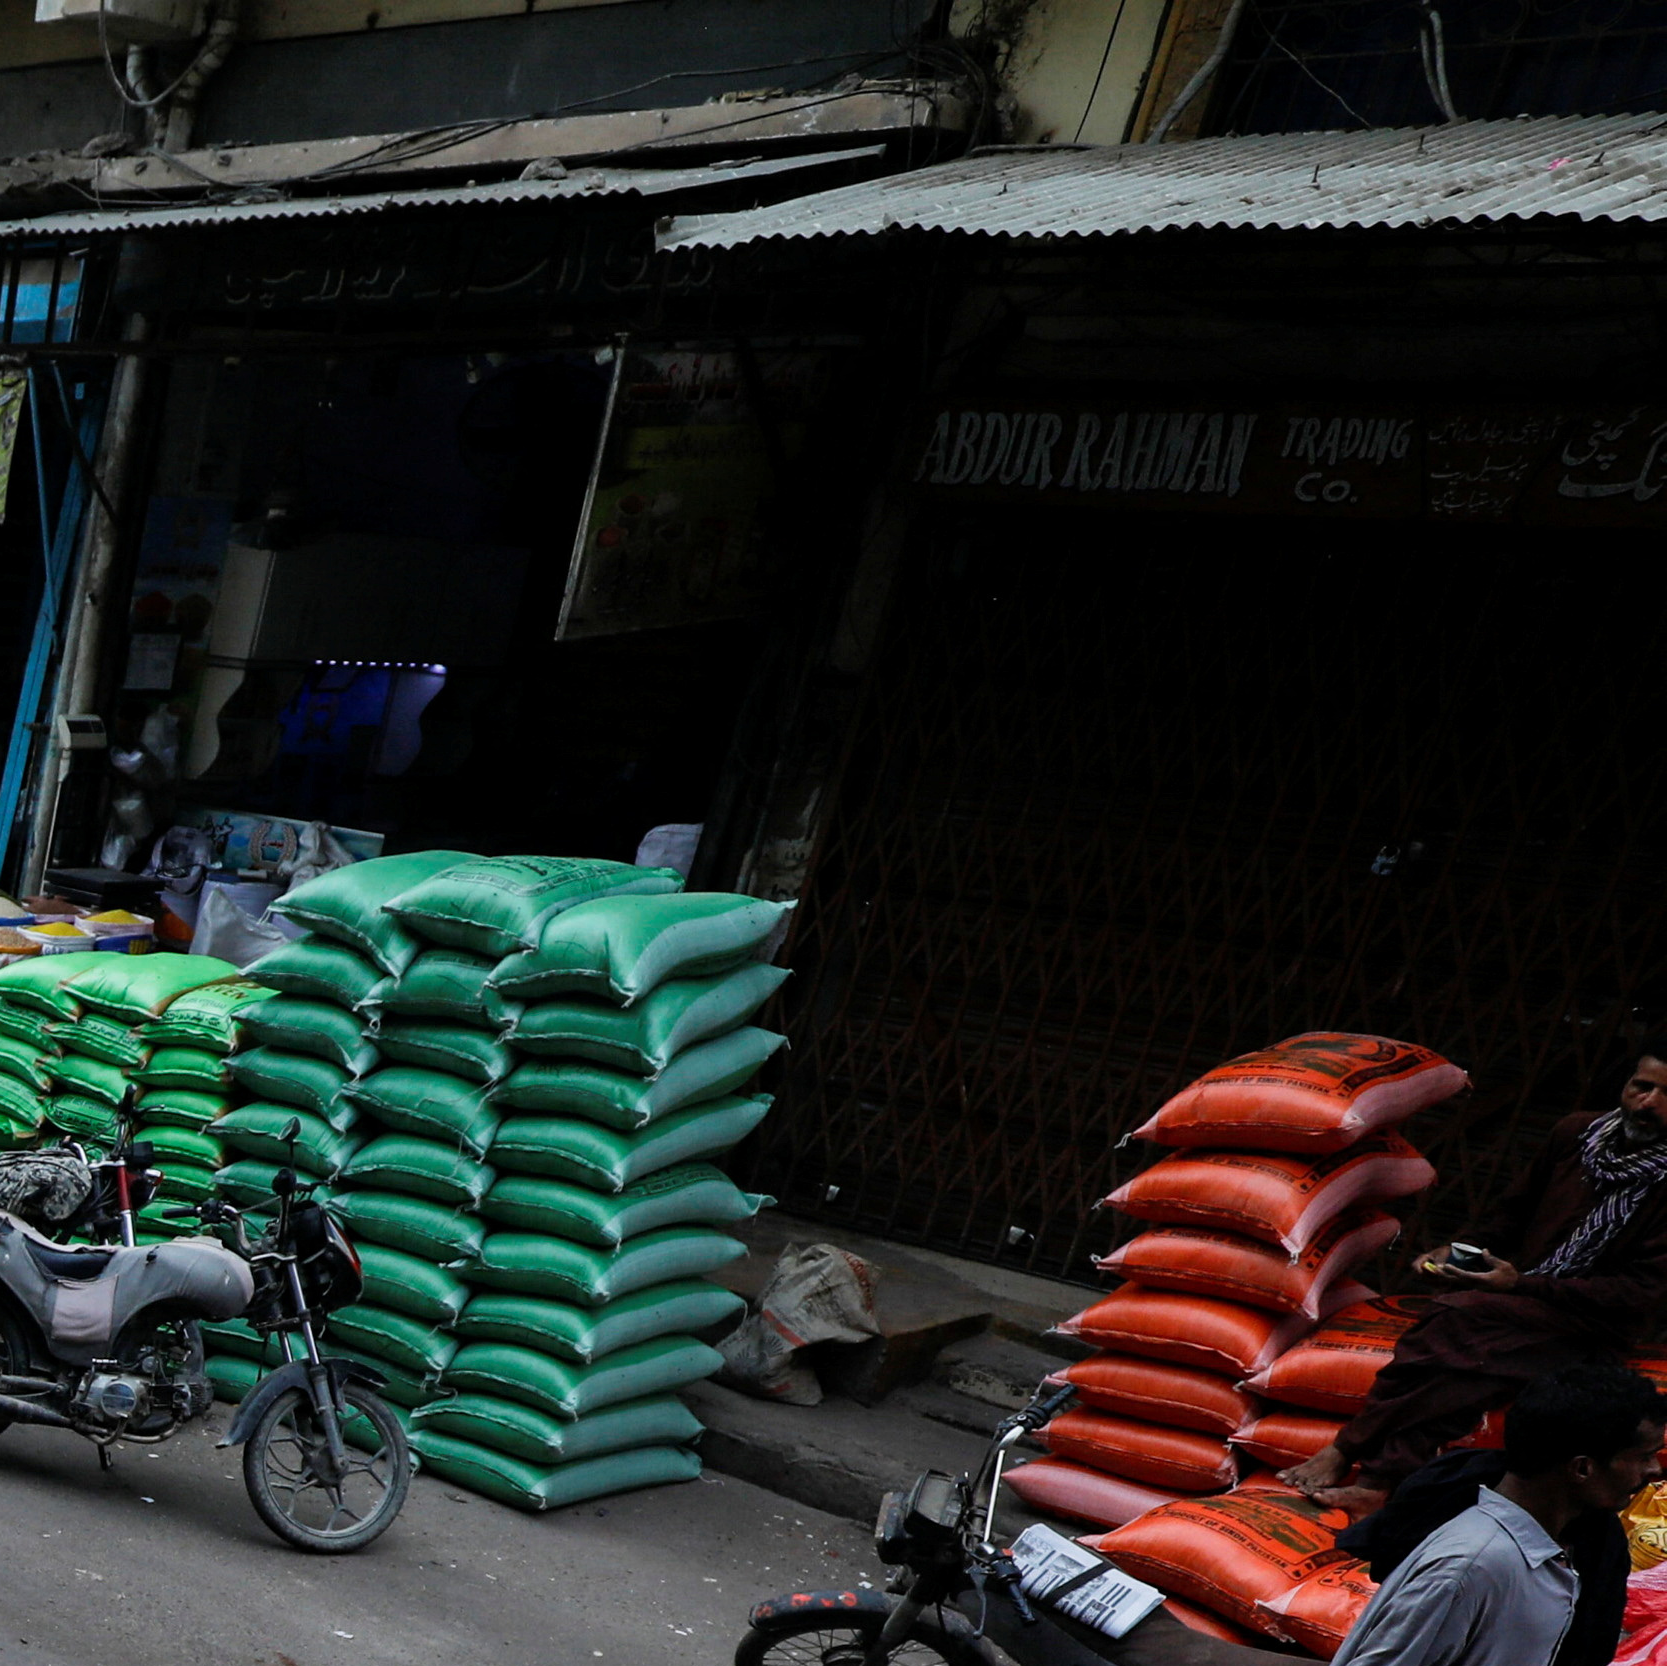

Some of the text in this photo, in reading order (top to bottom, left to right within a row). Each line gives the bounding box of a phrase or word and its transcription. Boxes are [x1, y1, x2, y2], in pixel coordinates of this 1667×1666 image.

[913, 410, 1258, 498] ABDUR RAHMAN
[1279, 416, 1414, 466] TRADING
[1167, 1509, 1289, 1570] PRODUCT OF SINDH PAKISTAN
